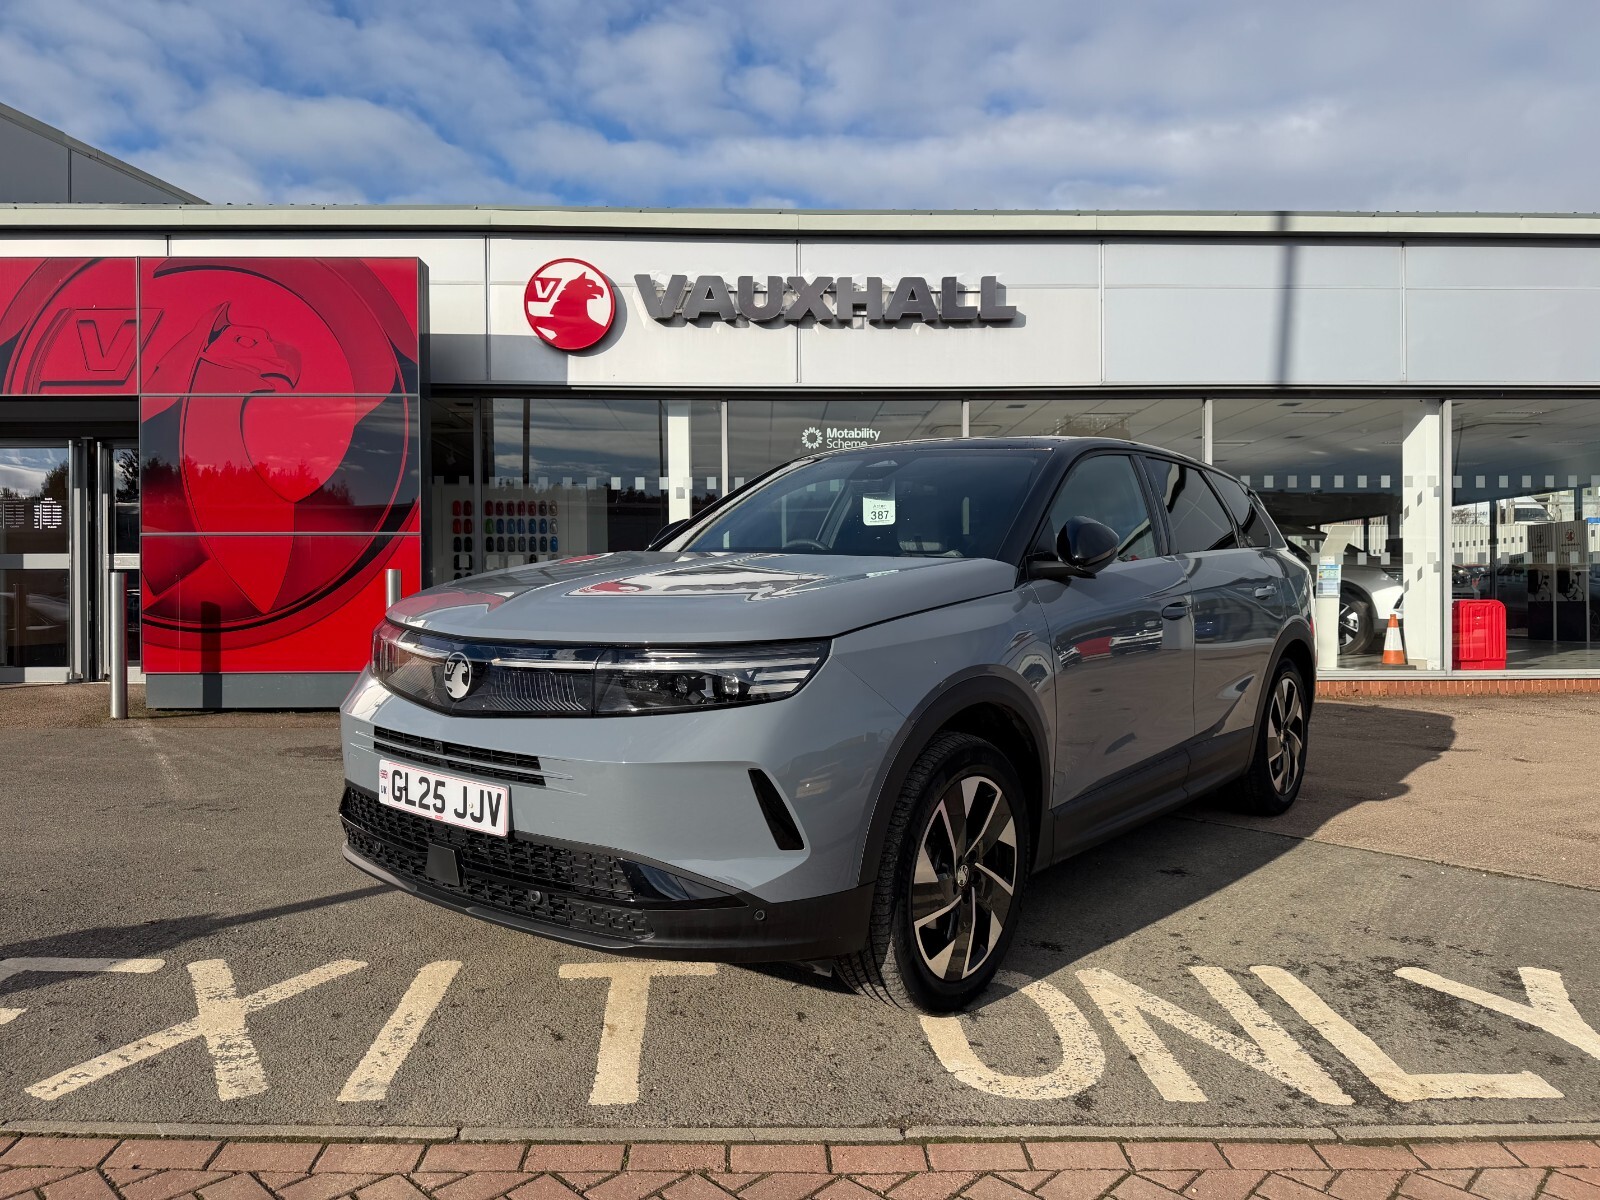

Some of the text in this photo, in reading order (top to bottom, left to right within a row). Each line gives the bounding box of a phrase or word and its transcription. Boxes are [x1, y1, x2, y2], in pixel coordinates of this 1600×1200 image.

[634, 274, 1017, 322] VAUXHALL
[826, 428, 881, 441] Motability
[870, 510, 889, 520] 387
[391, 769, 502, 827] GL25 JJV
